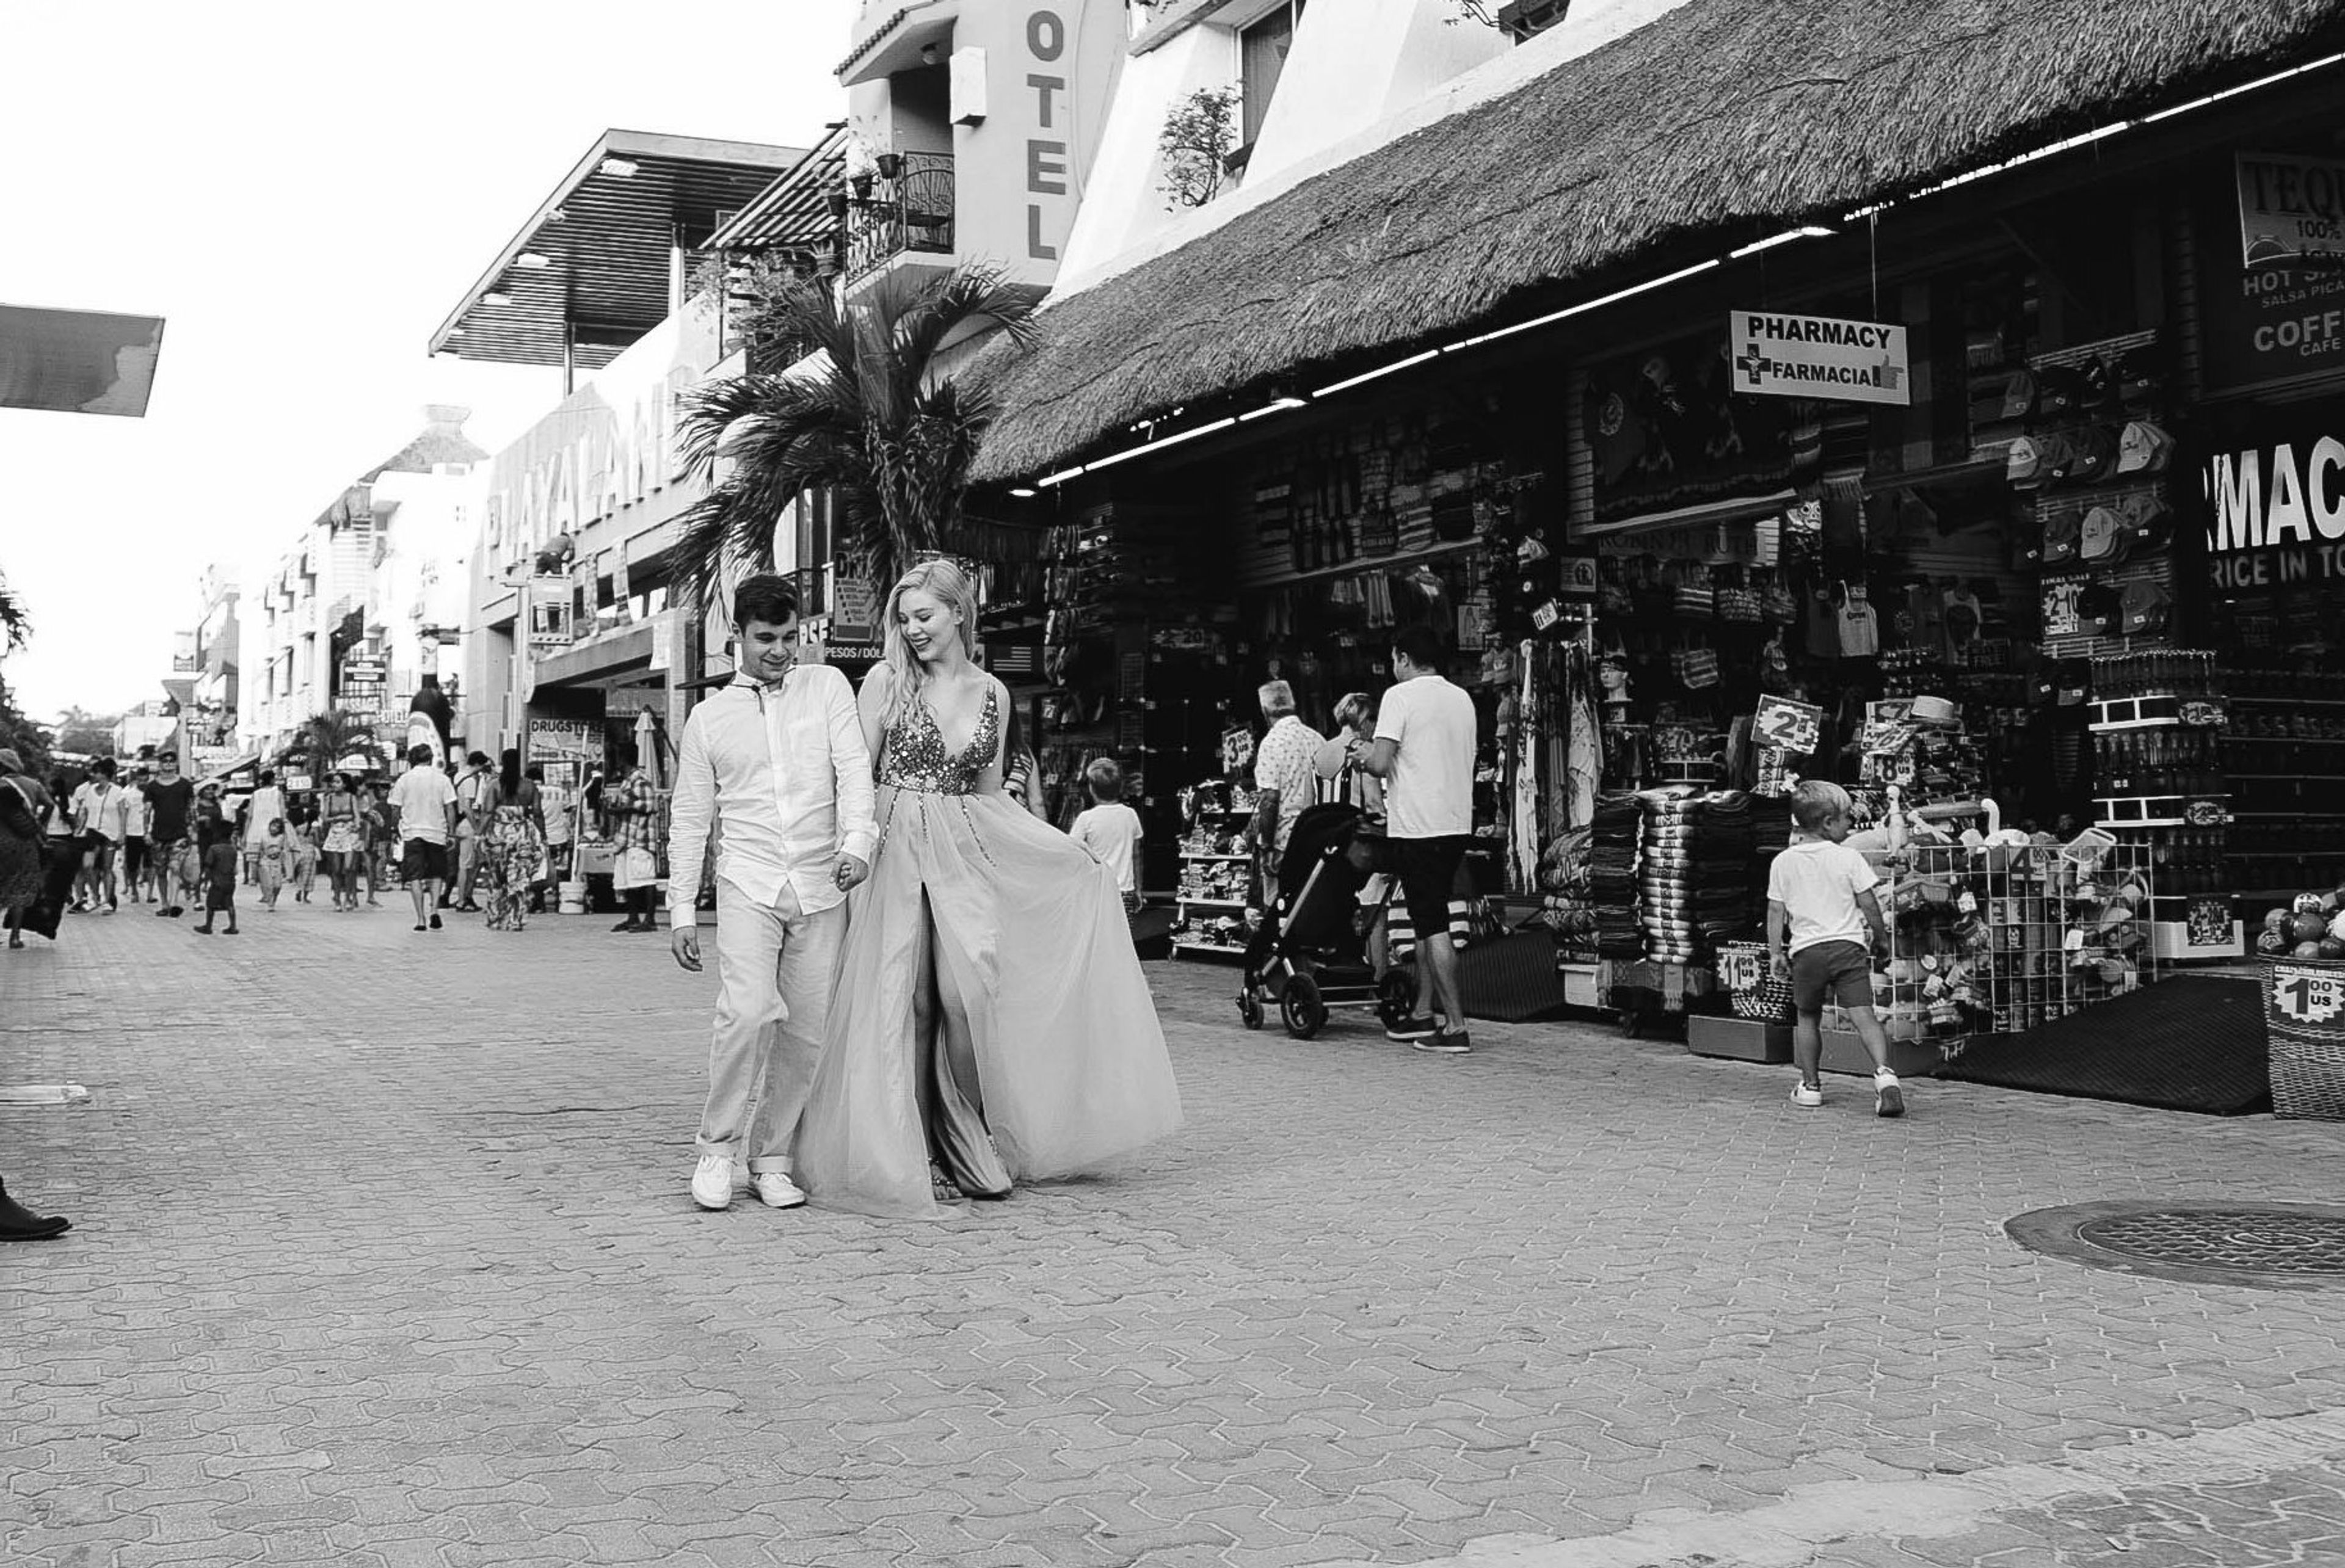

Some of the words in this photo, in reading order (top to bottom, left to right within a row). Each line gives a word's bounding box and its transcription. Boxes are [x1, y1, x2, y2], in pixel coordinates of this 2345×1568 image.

[1026, 10, 1066, 261] OTEL
[2243, 270, 2291, 296] HOT
[2262, 288, 2307, 308] SALSA
[1748, 316, 1891, 349] PHARMACY
[2254, 310, 2345, 352] COFF
[1772, 361, 1871, 386] FARMACIA
[2203, 435, 2345, 552] MAC
[2280, 550, 2308, 583] IN
[825, 646, 885, 658] PESOS/DOL
[1227, 736, 1238, 763] 3
[2285, 978, 2308, 1014] 1
[2310, 979, 2332, 992] 00
[2310, 995, 2332, 1007] US
